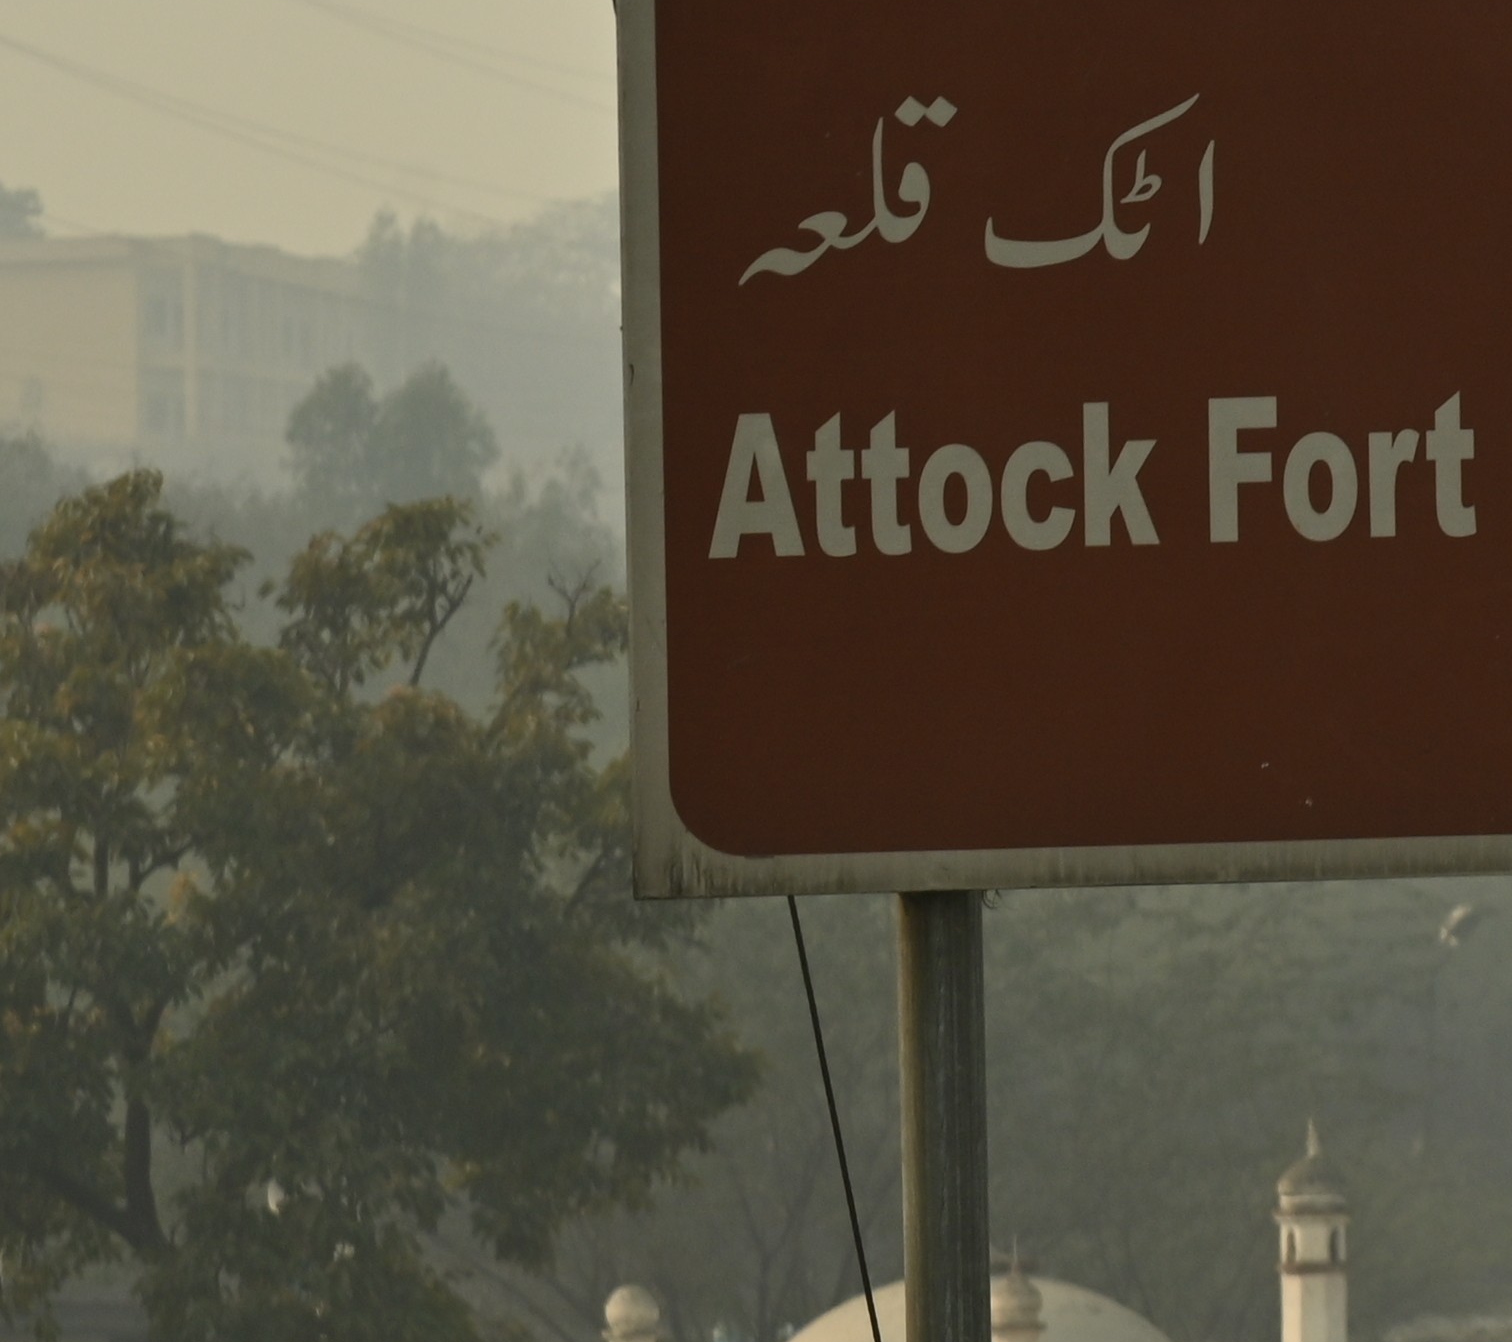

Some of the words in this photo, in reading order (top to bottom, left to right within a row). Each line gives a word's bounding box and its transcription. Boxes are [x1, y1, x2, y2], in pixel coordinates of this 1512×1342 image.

[738, 95, 958, 286] قلعہ
[984, 92, 1216, 270] اٹک
[708, 401, 1160, 559] Attock
[1208, 390, 1477, 543] Fort
